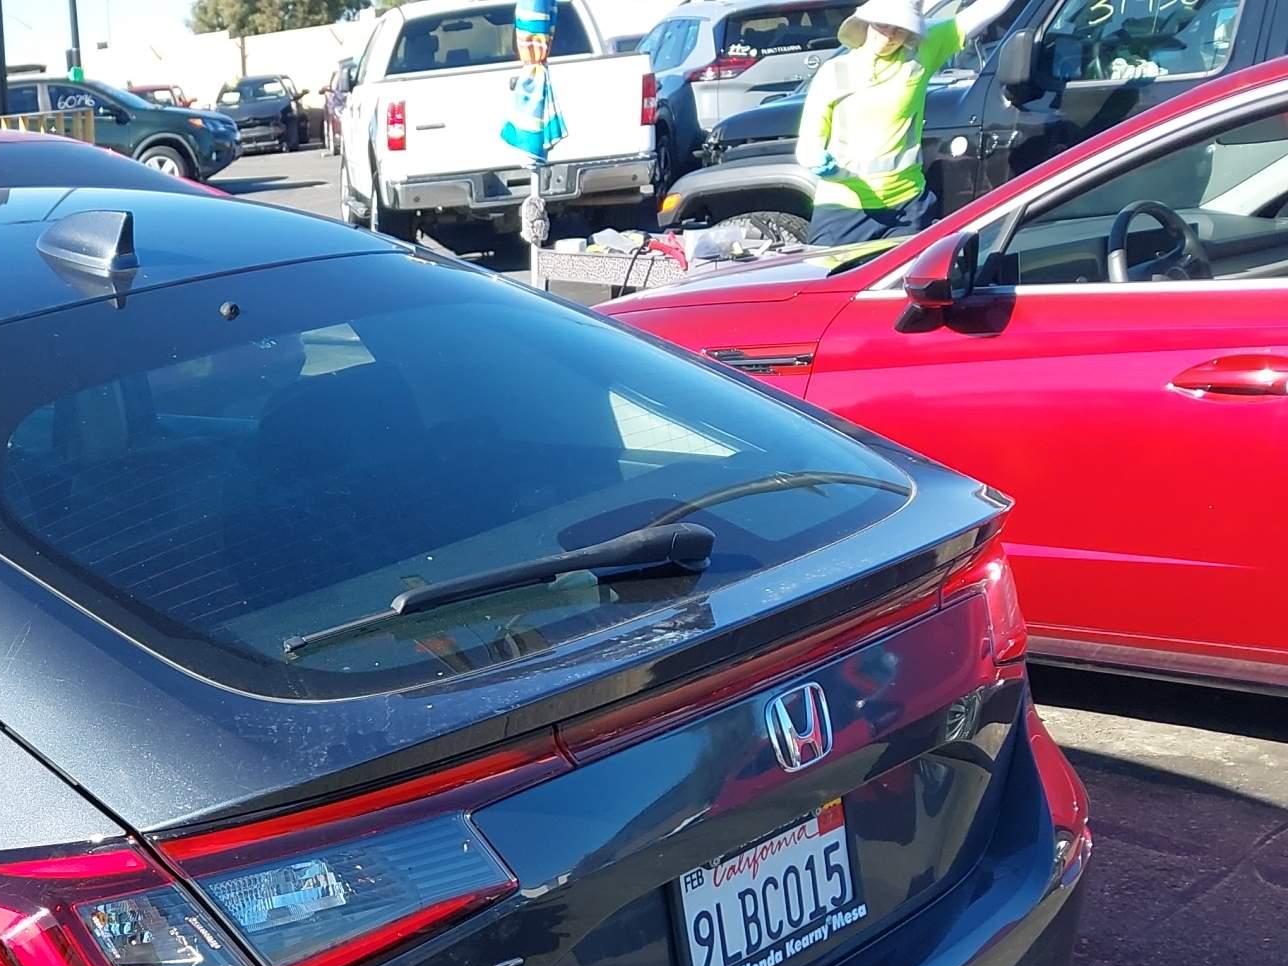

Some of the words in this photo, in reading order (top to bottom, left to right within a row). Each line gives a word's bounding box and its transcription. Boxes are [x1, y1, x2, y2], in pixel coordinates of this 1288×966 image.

[683, 868, 705, 894] FEB
[713, 823, 820, 888] California
[785, 919, 829, 958] Kearny
[831, 903, 867, 932] Mesa
